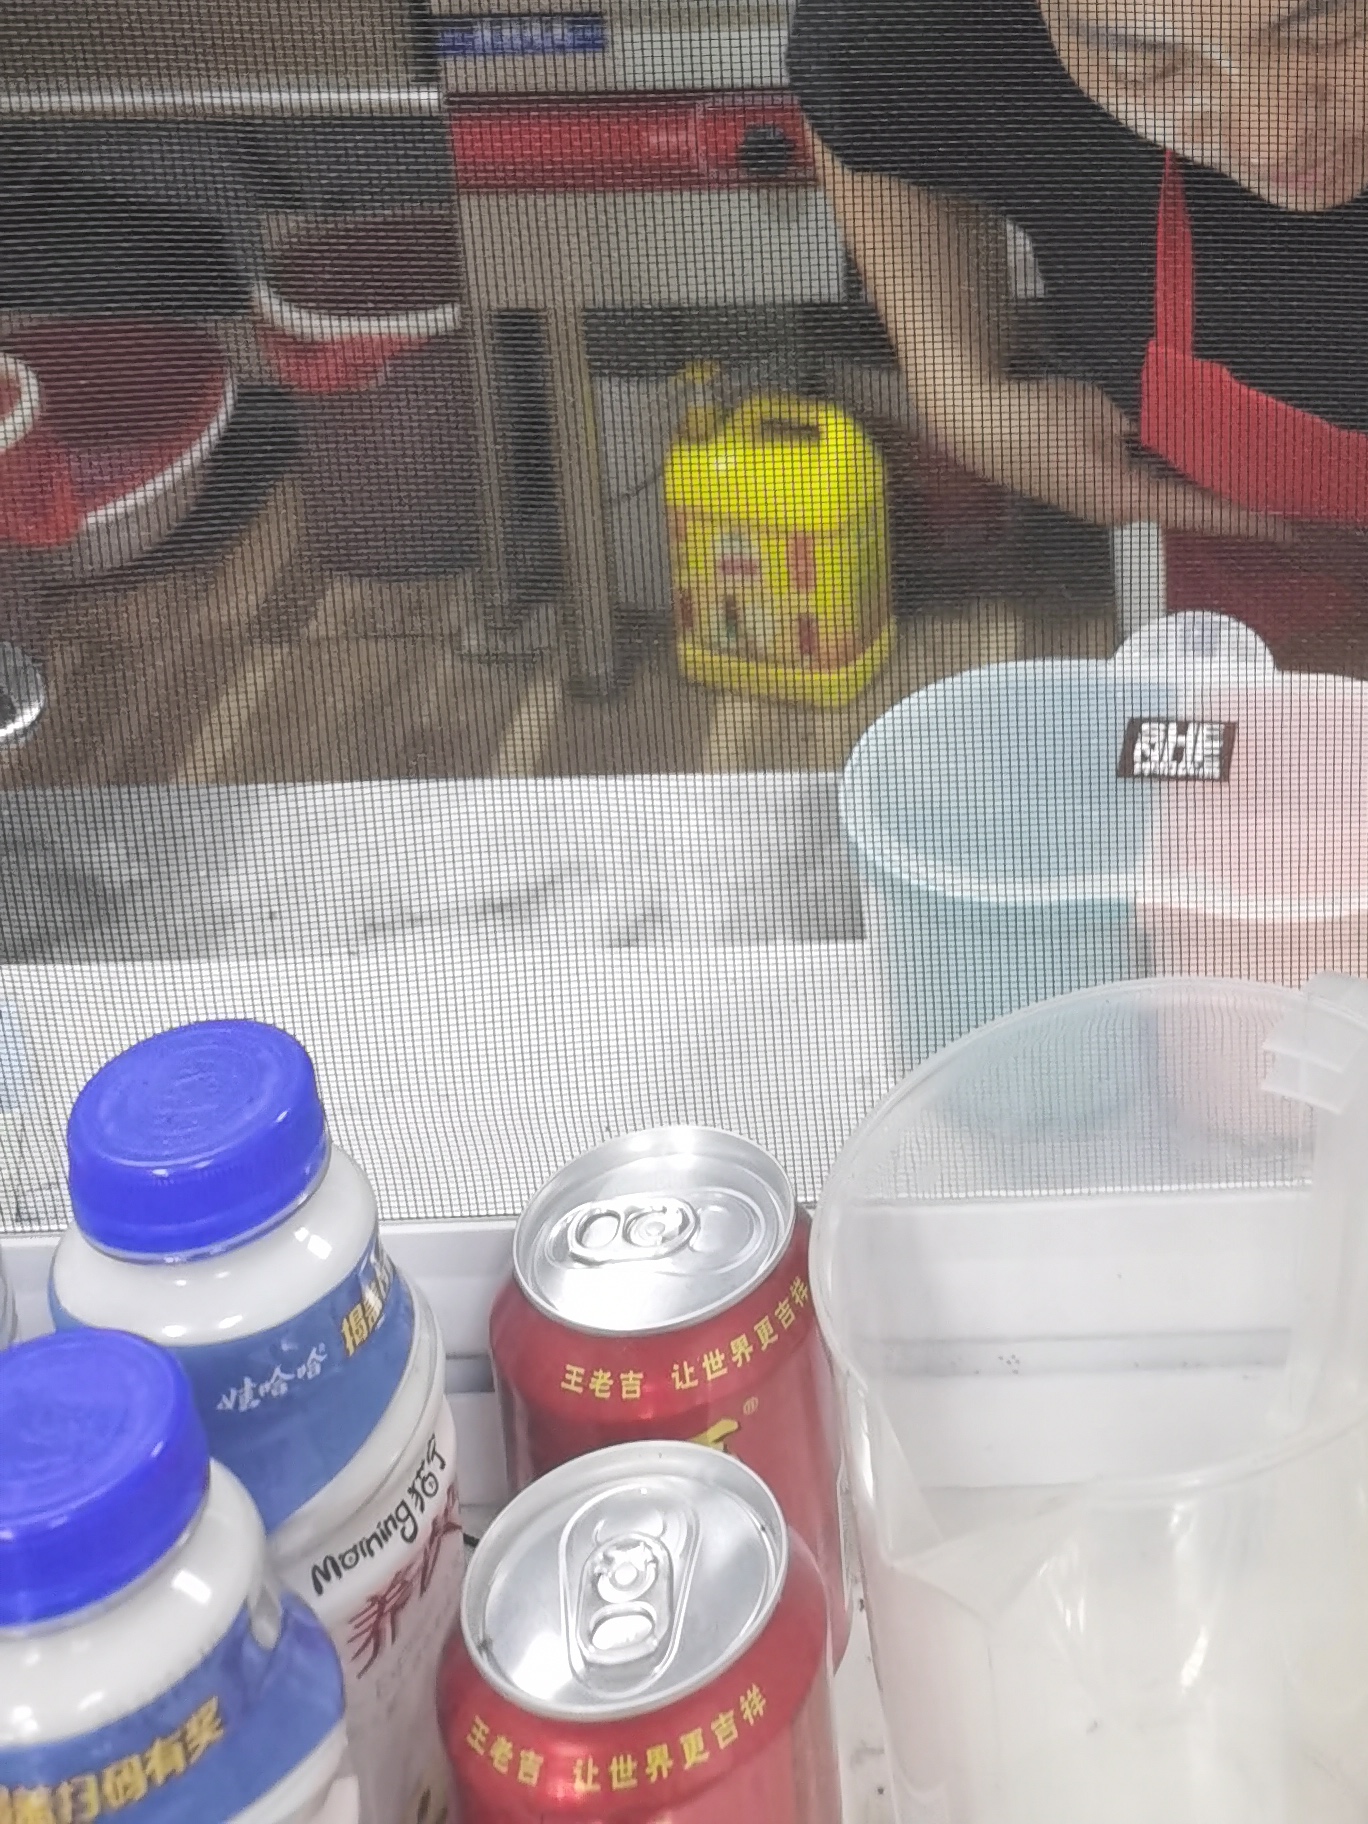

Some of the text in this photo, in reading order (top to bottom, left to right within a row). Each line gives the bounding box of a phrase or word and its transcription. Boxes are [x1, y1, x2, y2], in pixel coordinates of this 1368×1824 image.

[671, 1277, 810, 1391] 让世界更吉祥
[560, 1363, 644, 1401] 王老吉
[465, 1715, 545, 1788] 王老吉
[572, 1682, 768, 1793] 让世界更吉祥
